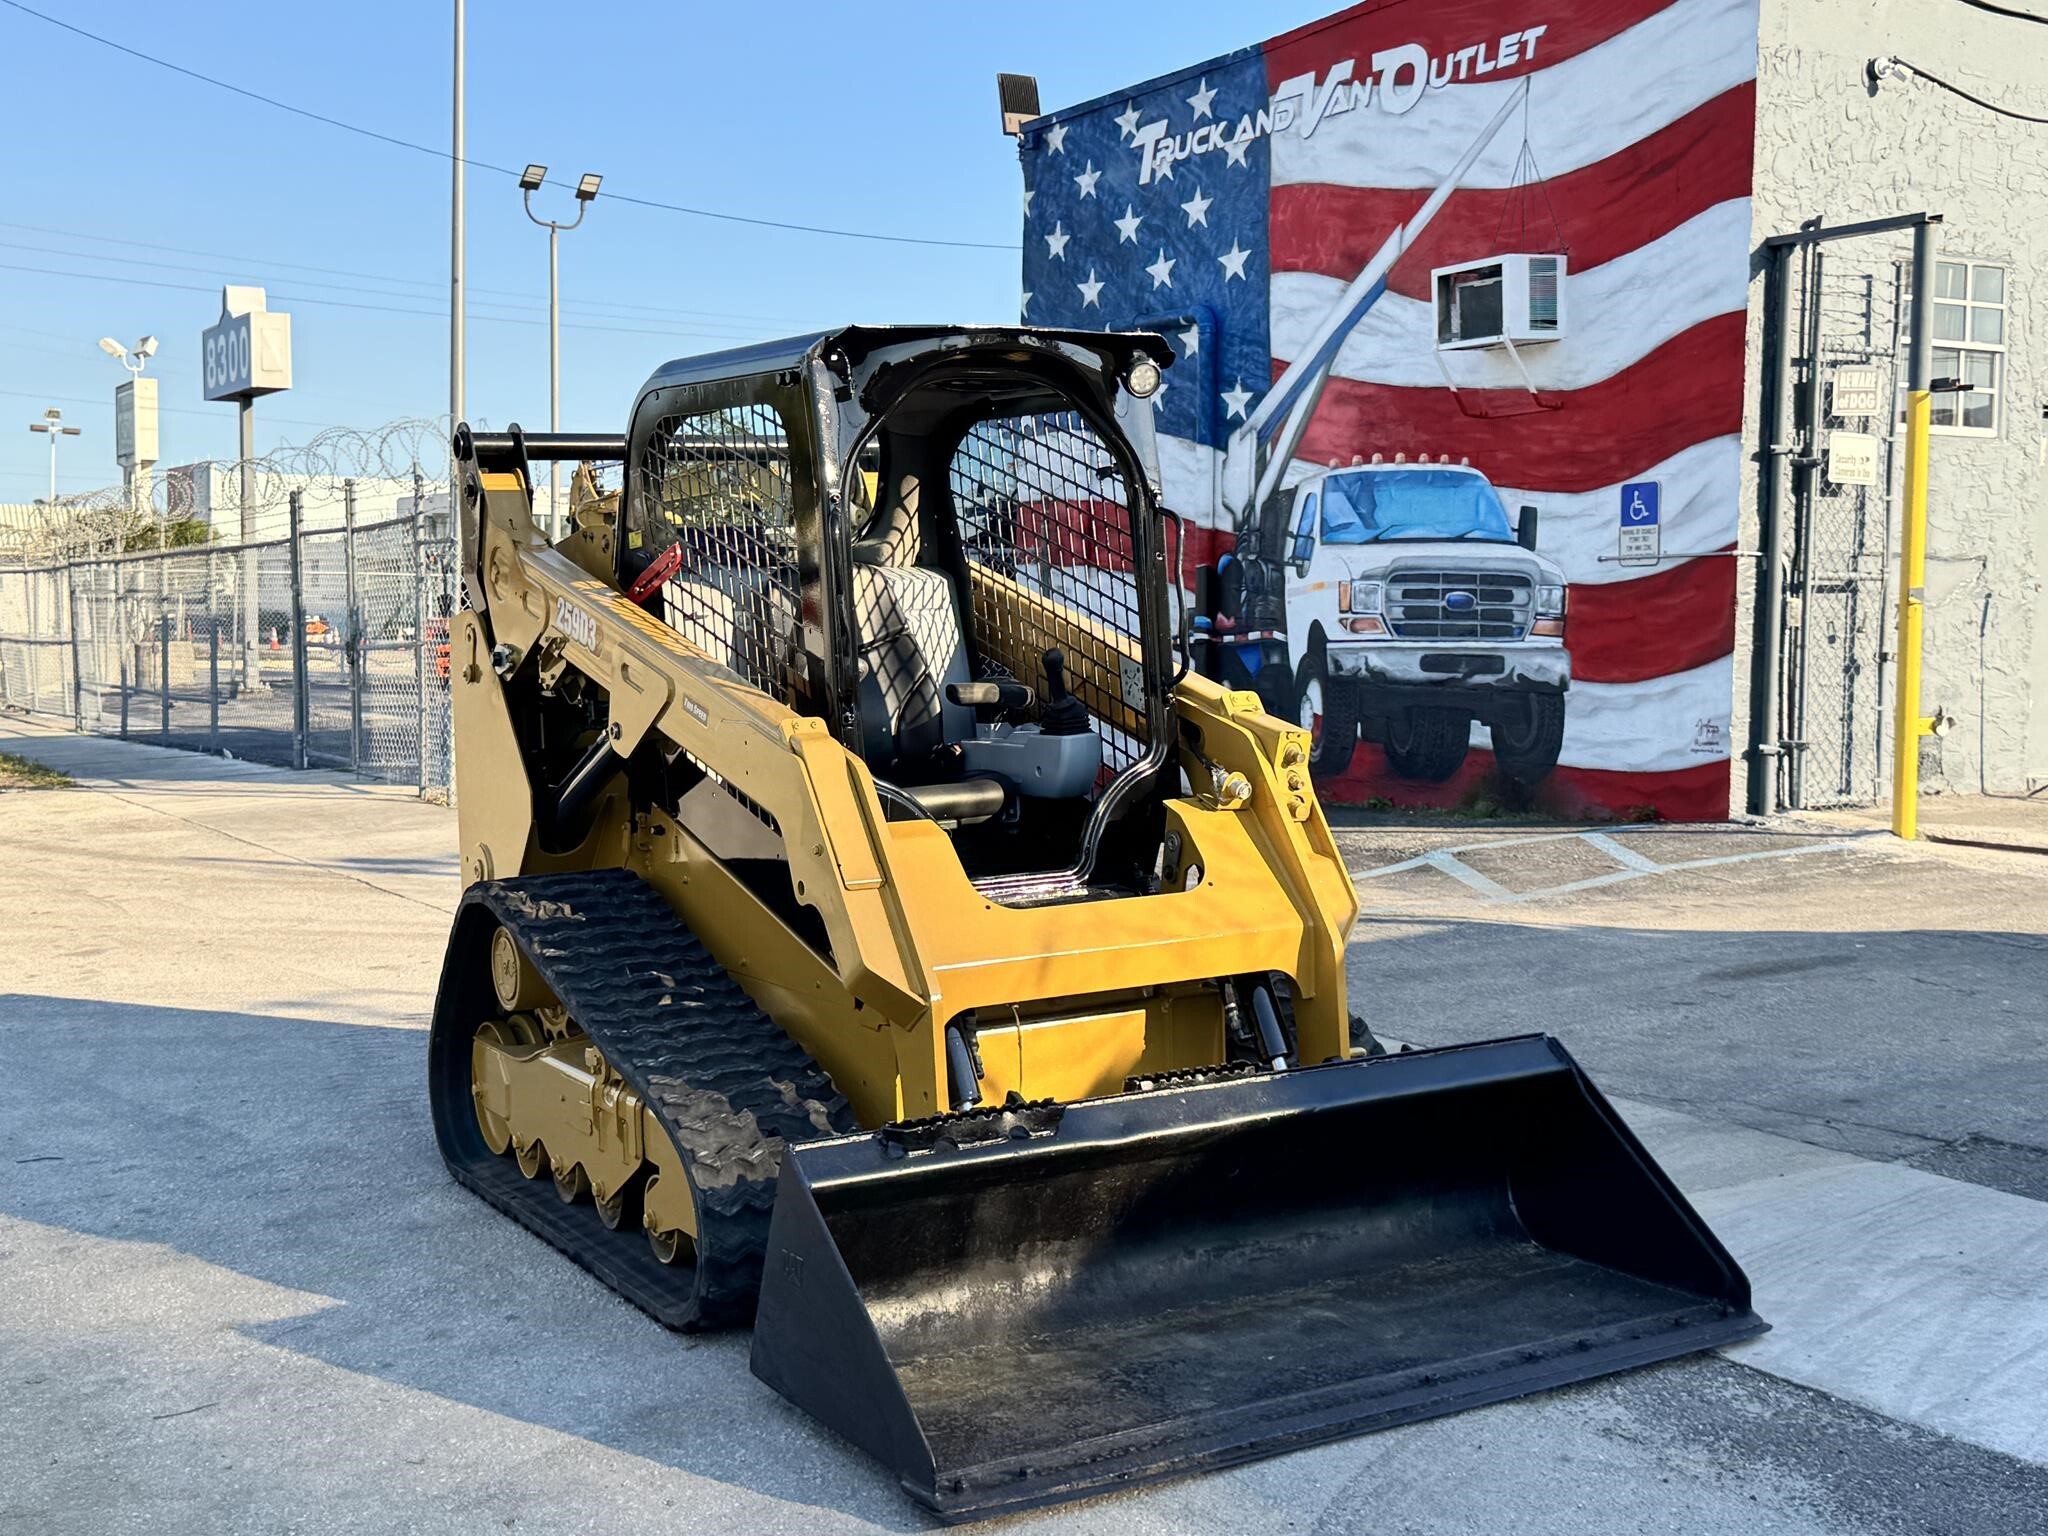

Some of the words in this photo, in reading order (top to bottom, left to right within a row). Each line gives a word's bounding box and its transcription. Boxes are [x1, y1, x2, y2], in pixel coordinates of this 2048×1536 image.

[1130, 118, 1228, 186] TRUCK
[1232, 101, 1295, 146] AND
[1274, 60, 1374, 140] VAN
[1372, 25, 1548, 116] OUTLET
[206, 325, 249, 390] 8300
[1839, 371, 1877, 388] BEWARE
[1849, 392, 1877, 409] DOG
[556, 596, 597, 652] 259D3
